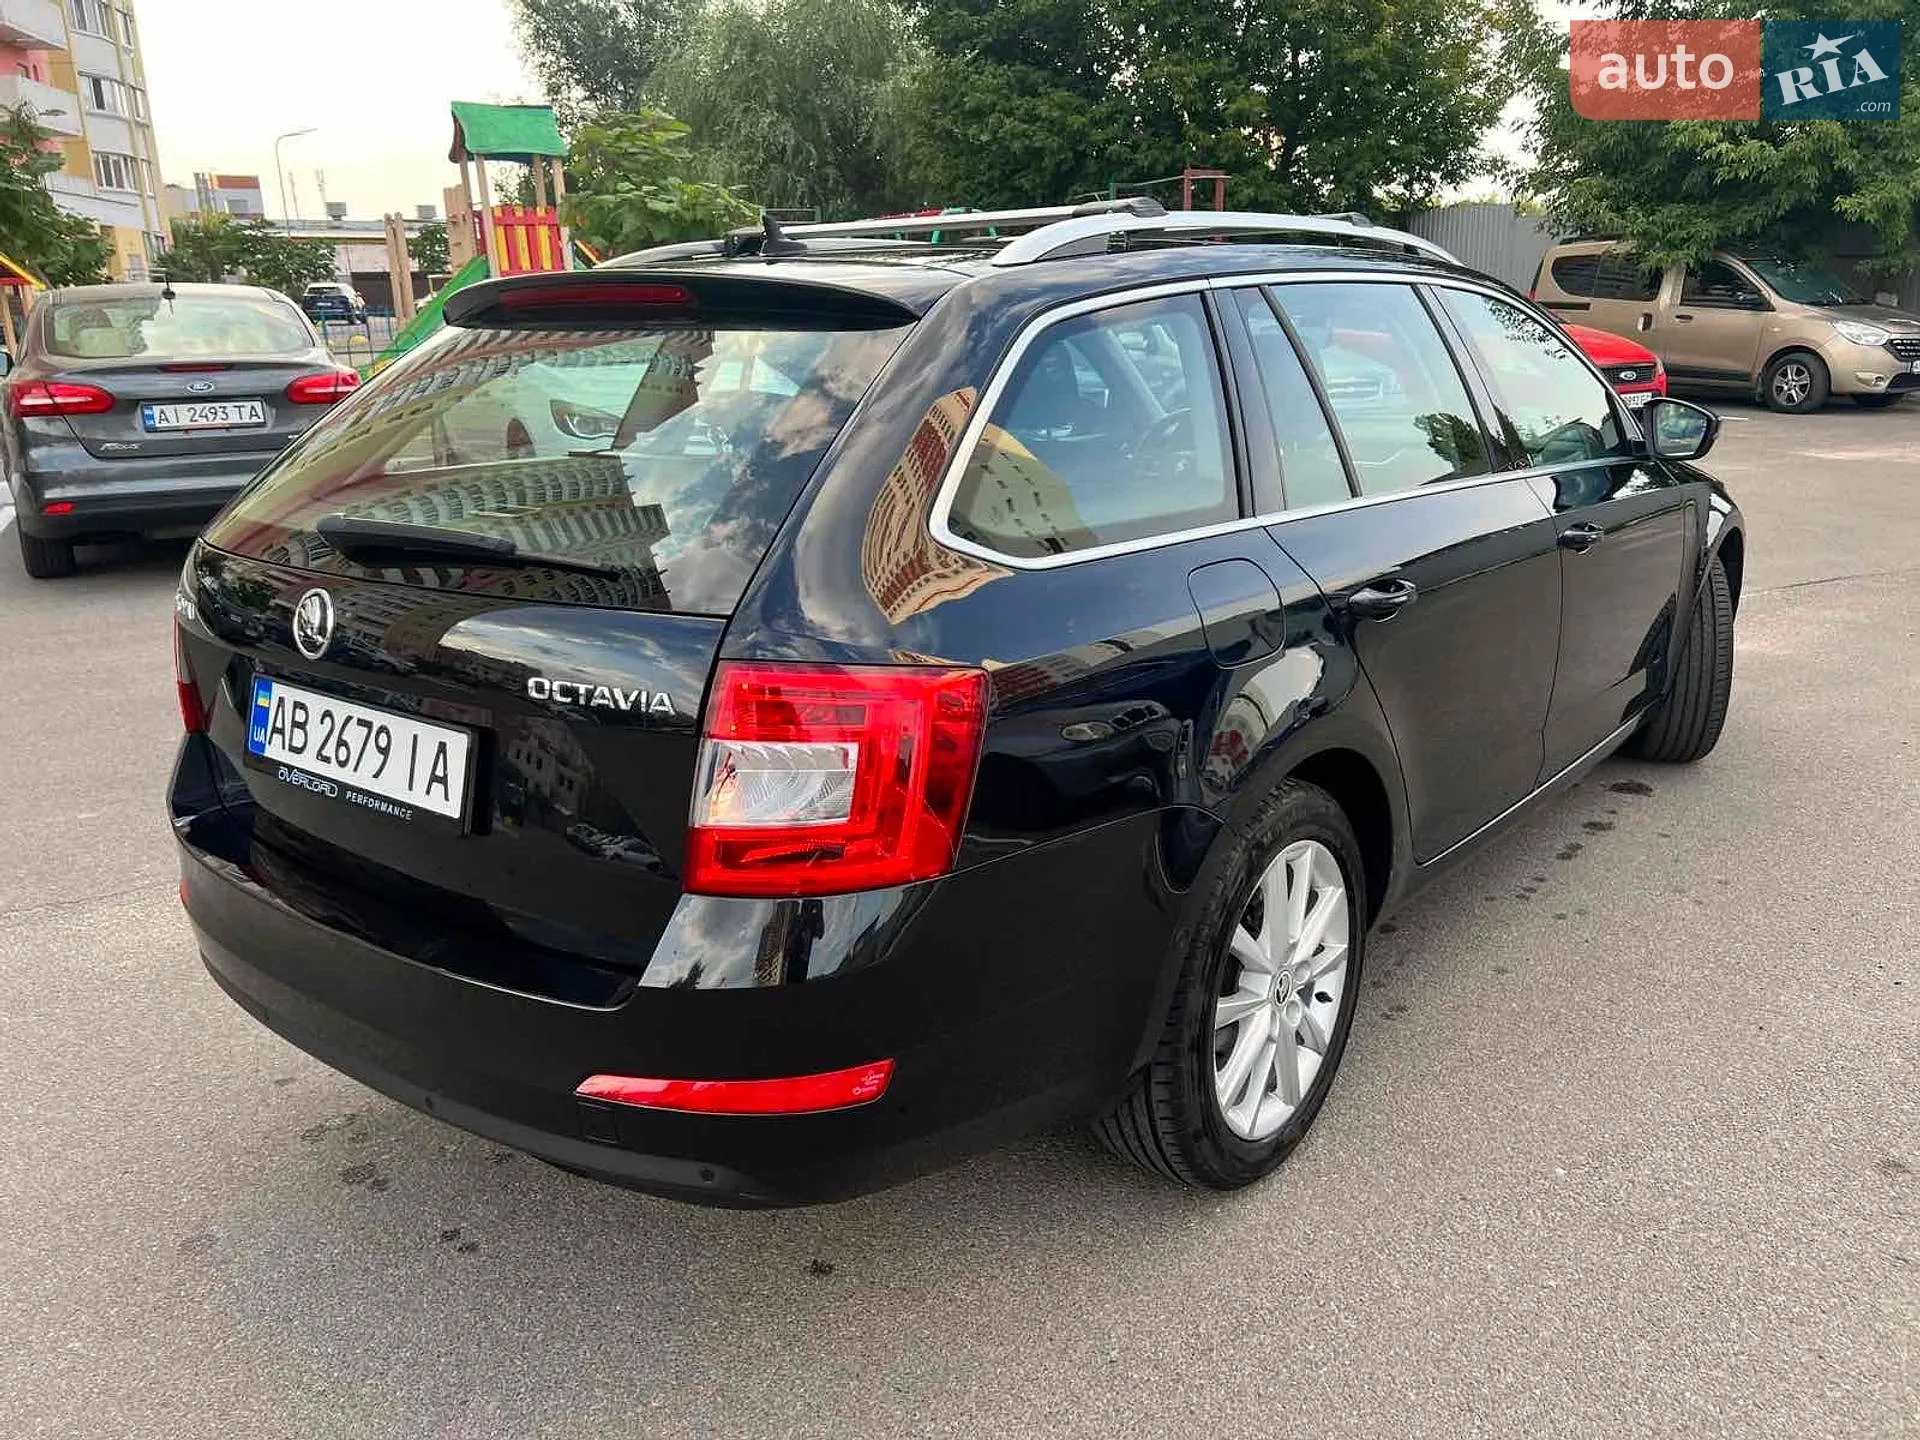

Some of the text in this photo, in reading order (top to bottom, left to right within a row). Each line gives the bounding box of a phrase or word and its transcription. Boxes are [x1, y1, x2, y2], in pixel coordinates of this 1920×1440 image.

[158, 405, 261, 425] AI 2493 TA
[527, 677, 676, 715] OCTAVIA
[253, 726, 266, 744] UA
[267, 696, 450, 802] AB 2679 IA
[345, 789, 413, 820] PERFORMANCE
